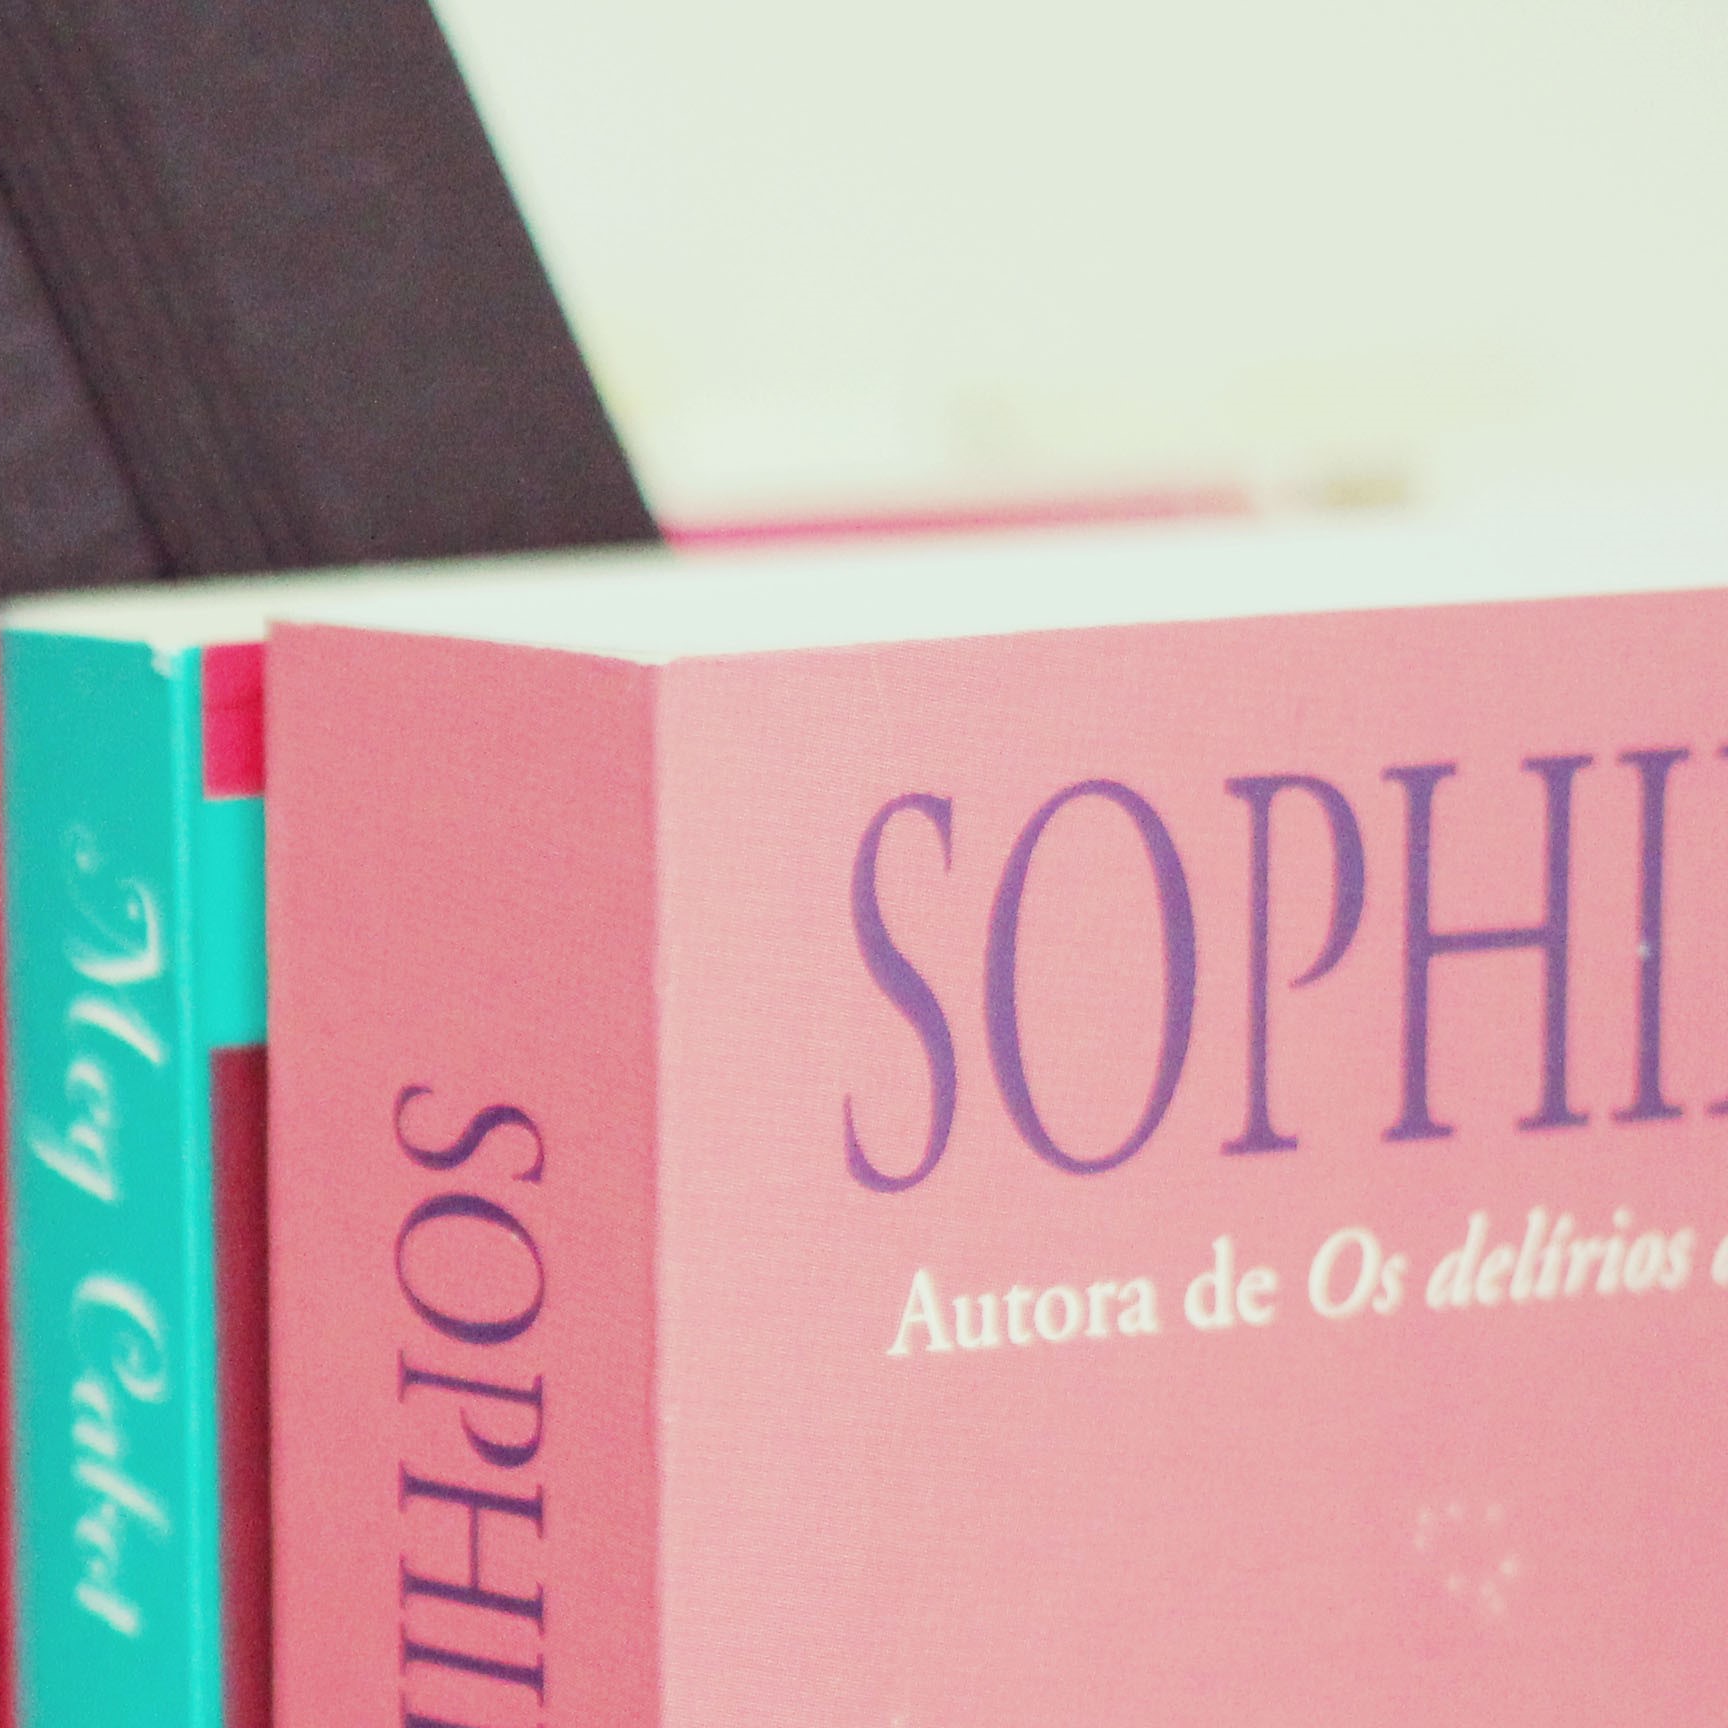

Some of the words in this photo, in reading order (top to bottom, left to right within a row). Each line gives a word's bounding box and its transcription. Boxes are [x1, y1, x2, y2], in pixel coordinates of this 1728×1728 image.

[31, 820, 167, 1203] Meg
[842, 745, 1728, 1195] SOPHI
[70, 1271, 168, 1638] Cabot
[886, 1266, 1160, 1357] Autora
[1183, 1234, 1279, 1331] de
[1307, 1226, 1407, 1319] Os
[1426, 1206, 1692, 1312] delírios
